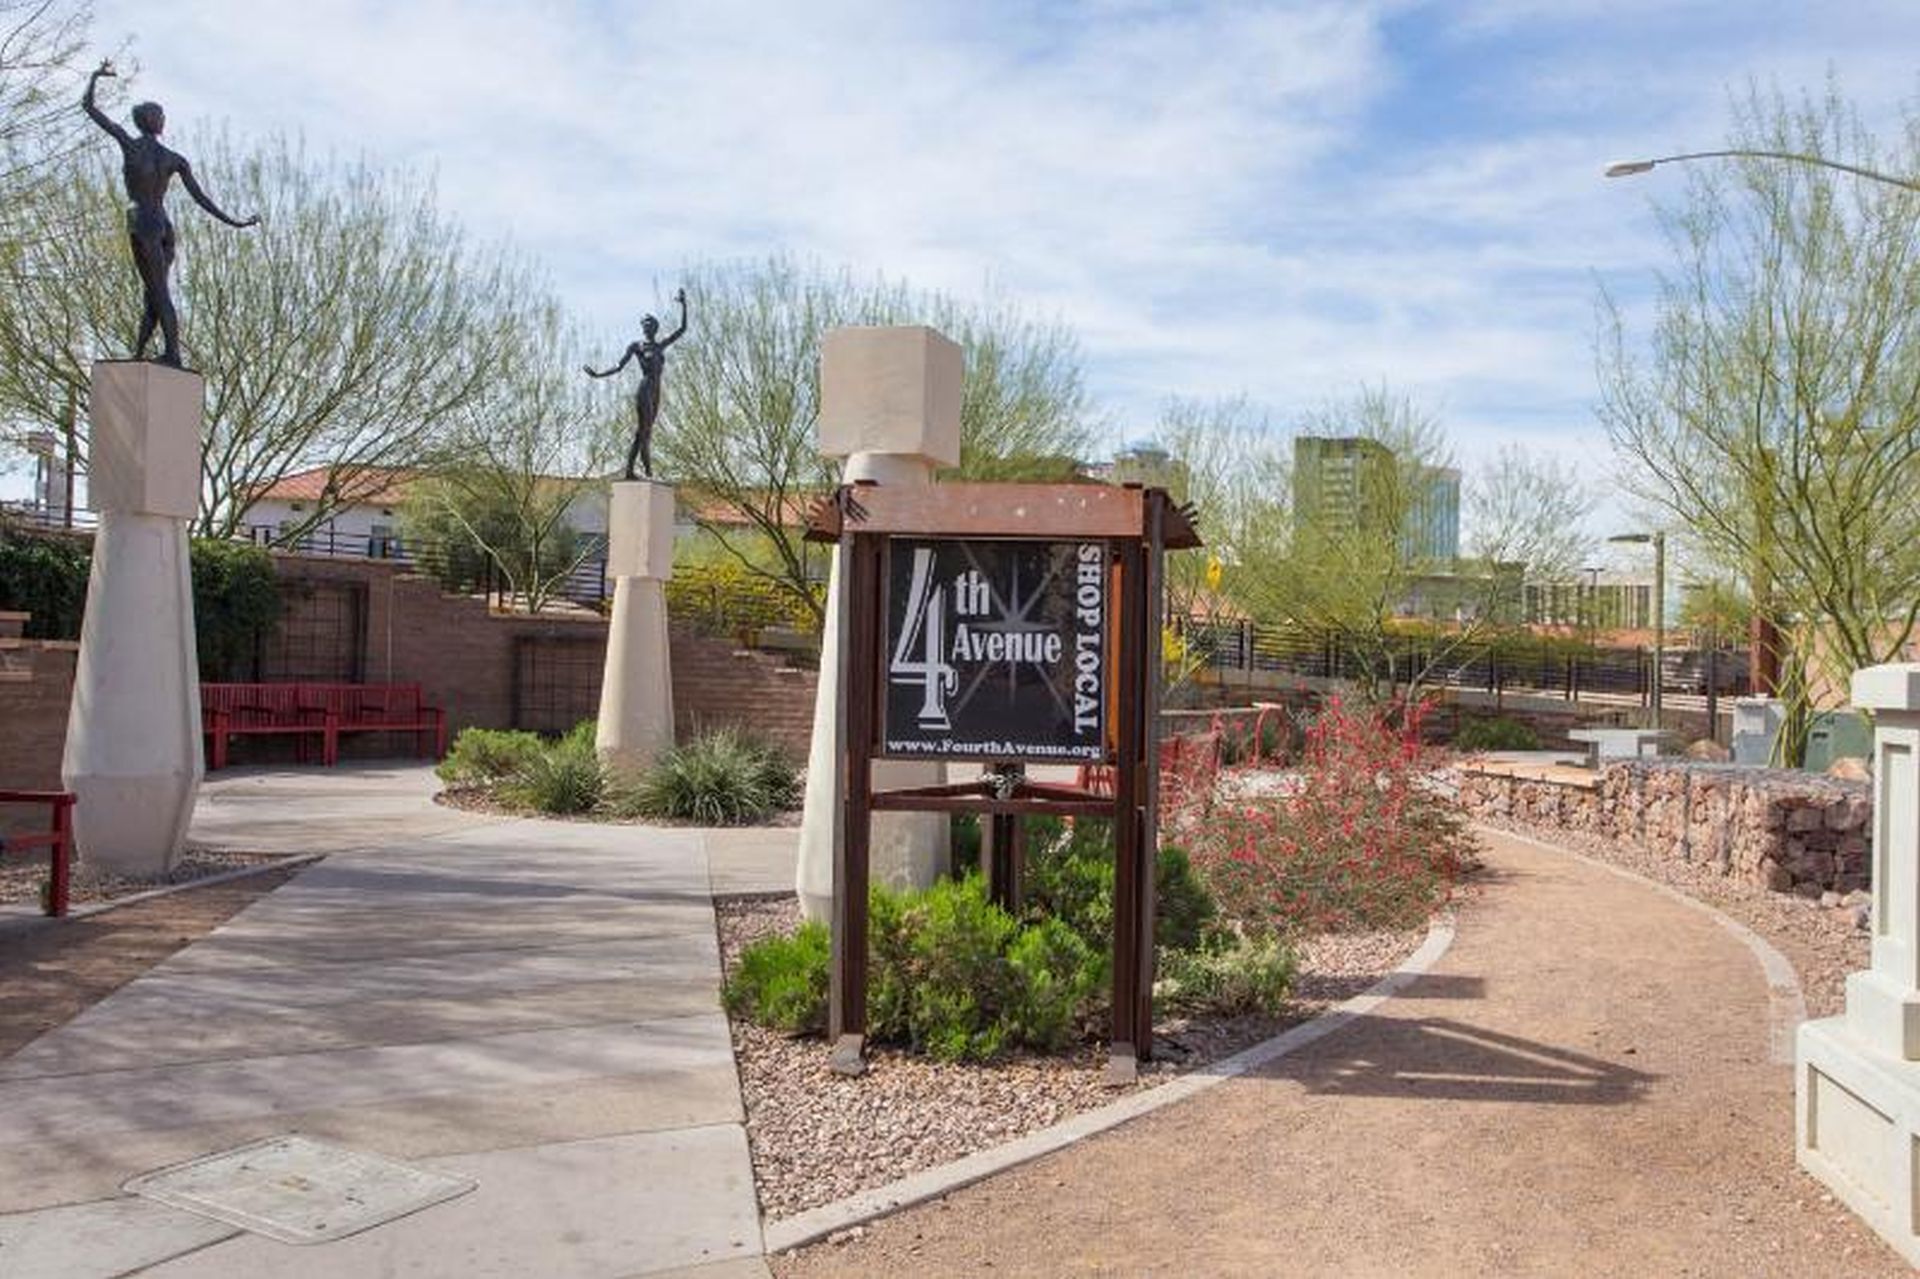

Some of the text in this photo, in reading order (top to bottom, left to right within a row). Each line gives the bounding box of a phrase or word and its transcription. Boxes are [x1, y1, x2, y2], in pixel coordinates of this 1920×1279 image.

[952, 622, 1063, 663] Avenue
[1074, 543, 1101, 735] SHOP LOCAL
[887, 737, 1101, 760] www.FourthAvenue.org
